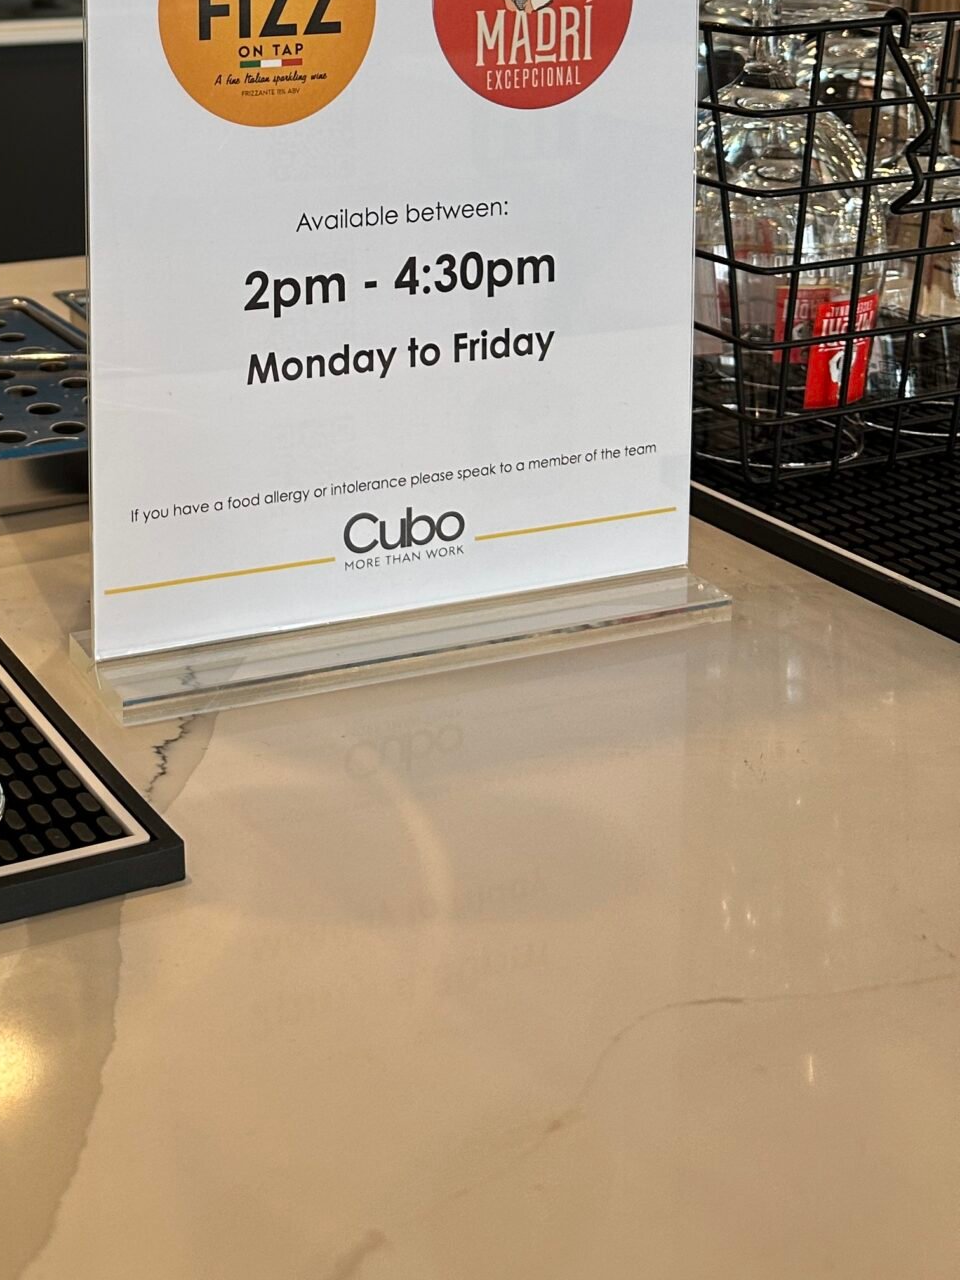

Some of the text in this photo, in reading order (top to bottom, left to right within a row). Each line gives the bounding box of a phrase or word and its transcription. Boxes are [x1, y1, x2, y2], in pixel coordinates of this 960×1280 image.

[238, 43, 304, 58] ON TAP
[214, 70, 328, 86] A fine Italian sparkling wine
[241, 88, 275, 97] FRIZZANTE
[287, 87, 301, 95] ABV
[485, 64, 582, 91] EXCEPCIONAL
[296, 197, 509, 234] Available between:
[243, 251, 557, 319] 2pm - 4:30pm
[246, 327, 557, 387] Monday to Friday
[131, 443, 657, 524] If you have a food allergy or intolerance please speak to a member of the team
[343, 506, 466, 555] Cubo
[345, 545, 465, 571] MORE THAN WORK
